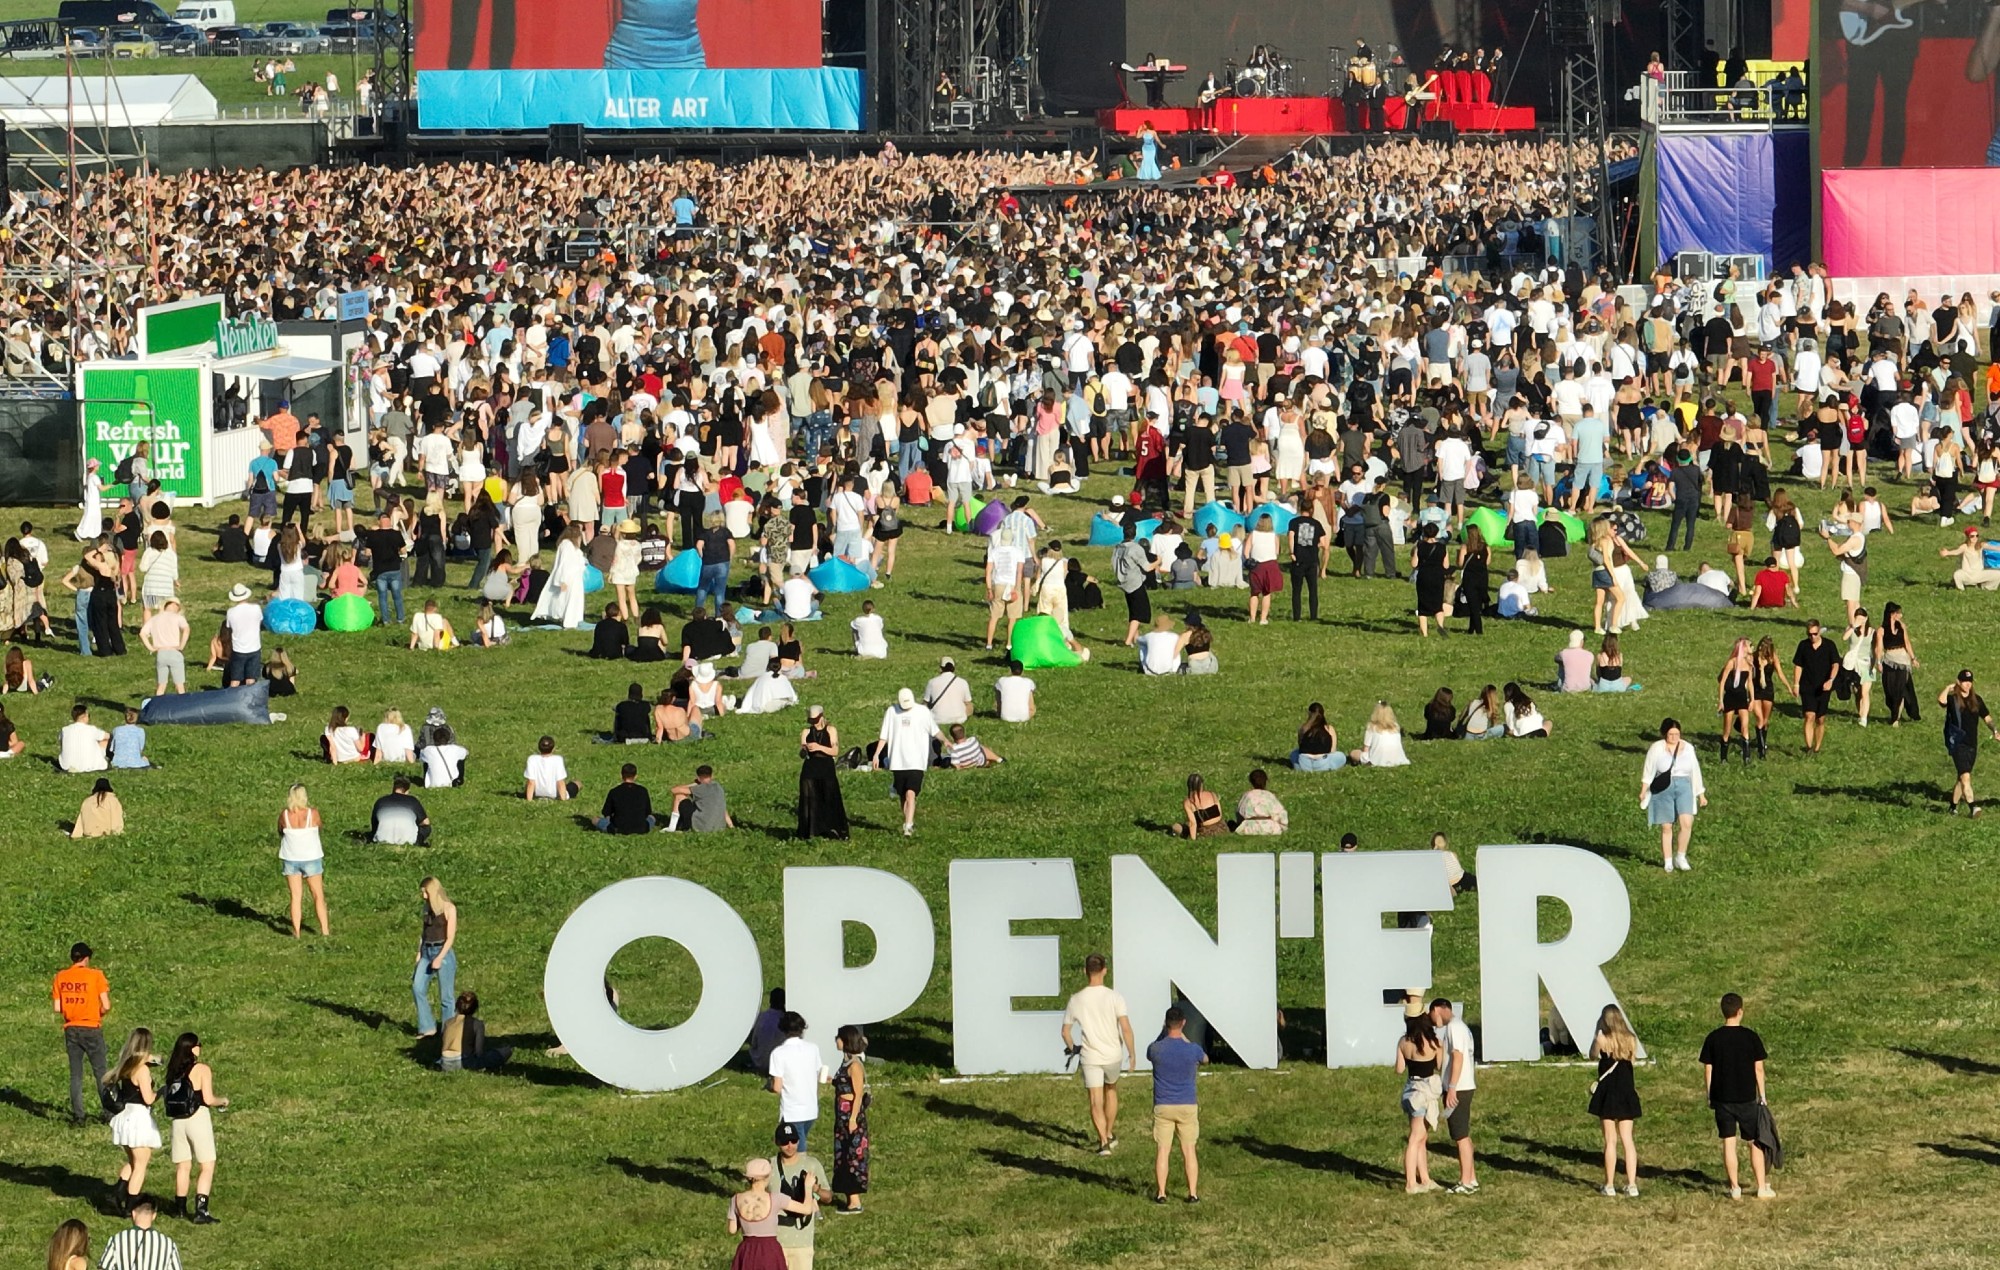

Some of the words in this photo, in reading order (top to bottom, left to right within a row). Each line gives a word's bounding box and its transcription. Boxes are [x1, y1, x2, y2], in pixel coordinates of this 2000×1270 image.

[604, 97, 660, 118] ALTER
[671, 97, 709, 118] ART
[217, 315, 278, 358] Heineken
[96, 420, 180, 441] Refresh
[1140, 440, 1149, 456] 5
[60, 982, 88, 991] FORT
